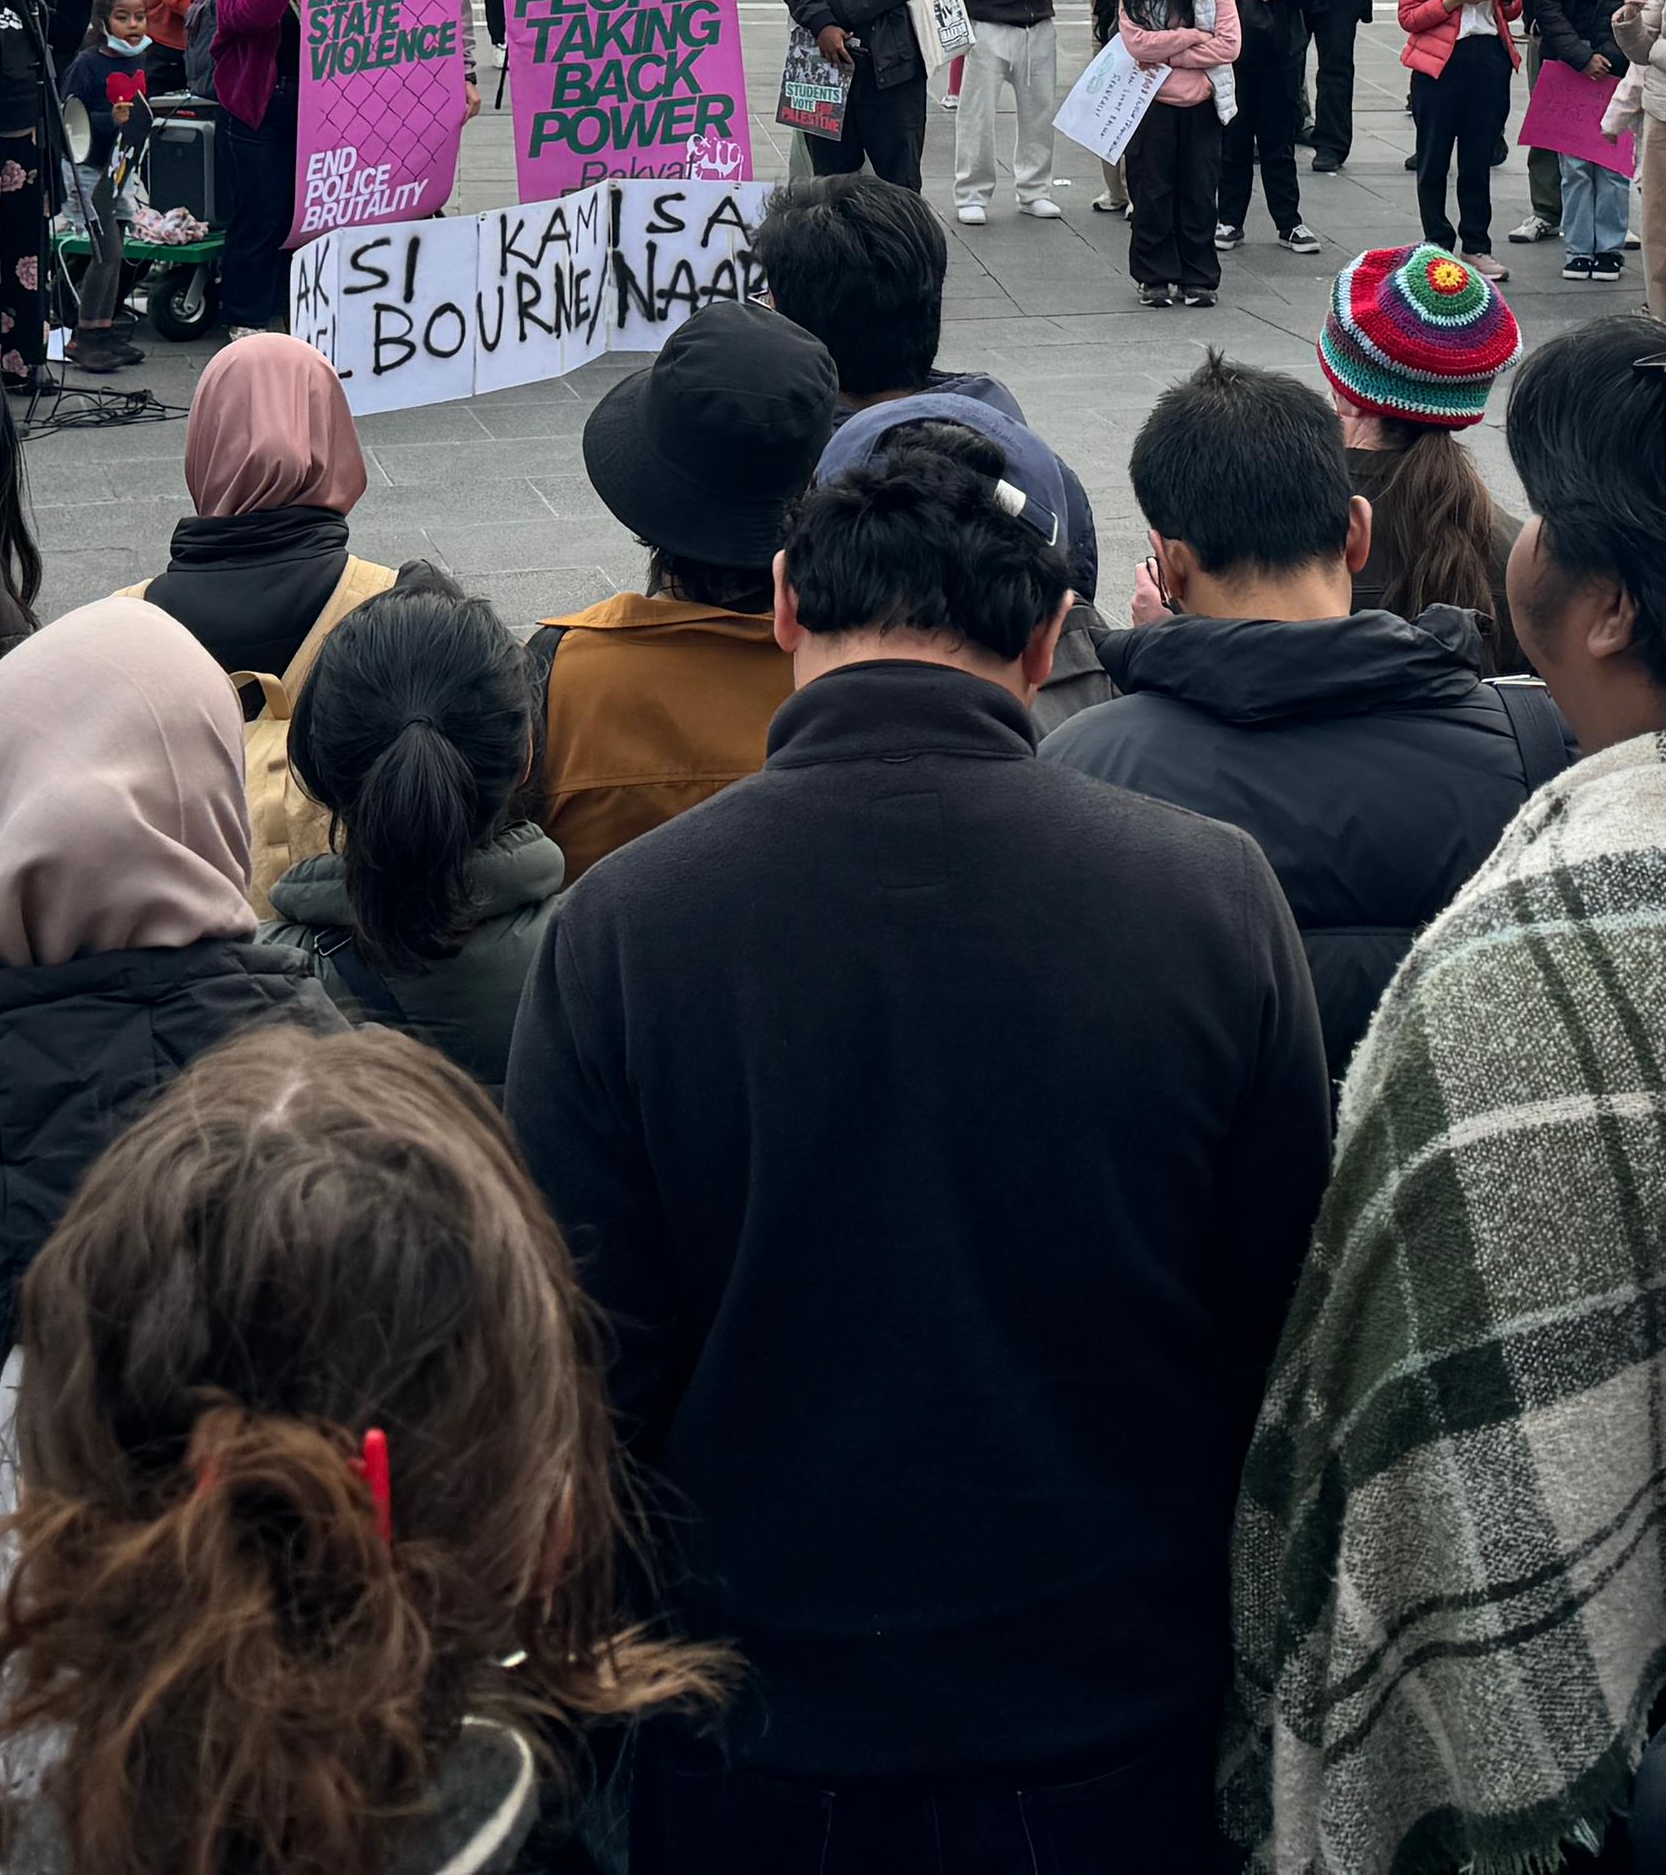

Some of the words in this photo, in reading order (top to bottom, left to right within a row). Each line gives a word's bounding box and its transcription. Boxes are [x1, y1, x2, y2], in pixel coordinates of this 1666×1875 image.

[311, 20, 457, 81] VIOLENCE
[526, 0, 721, 64] TAKING
[552, 47, 707, 110] BACK
[786, 84, 840, 101] STUDENTS
[792, 98, 814, 111] VOTE
[528, 93, 735, 159] POWER
[304, 164, 391, 208] POLICE
[306, 146, 358, 181] END
[300, 178, 429, 233] BRUTALITY
[500, 188, 754, 276] KAMISA
